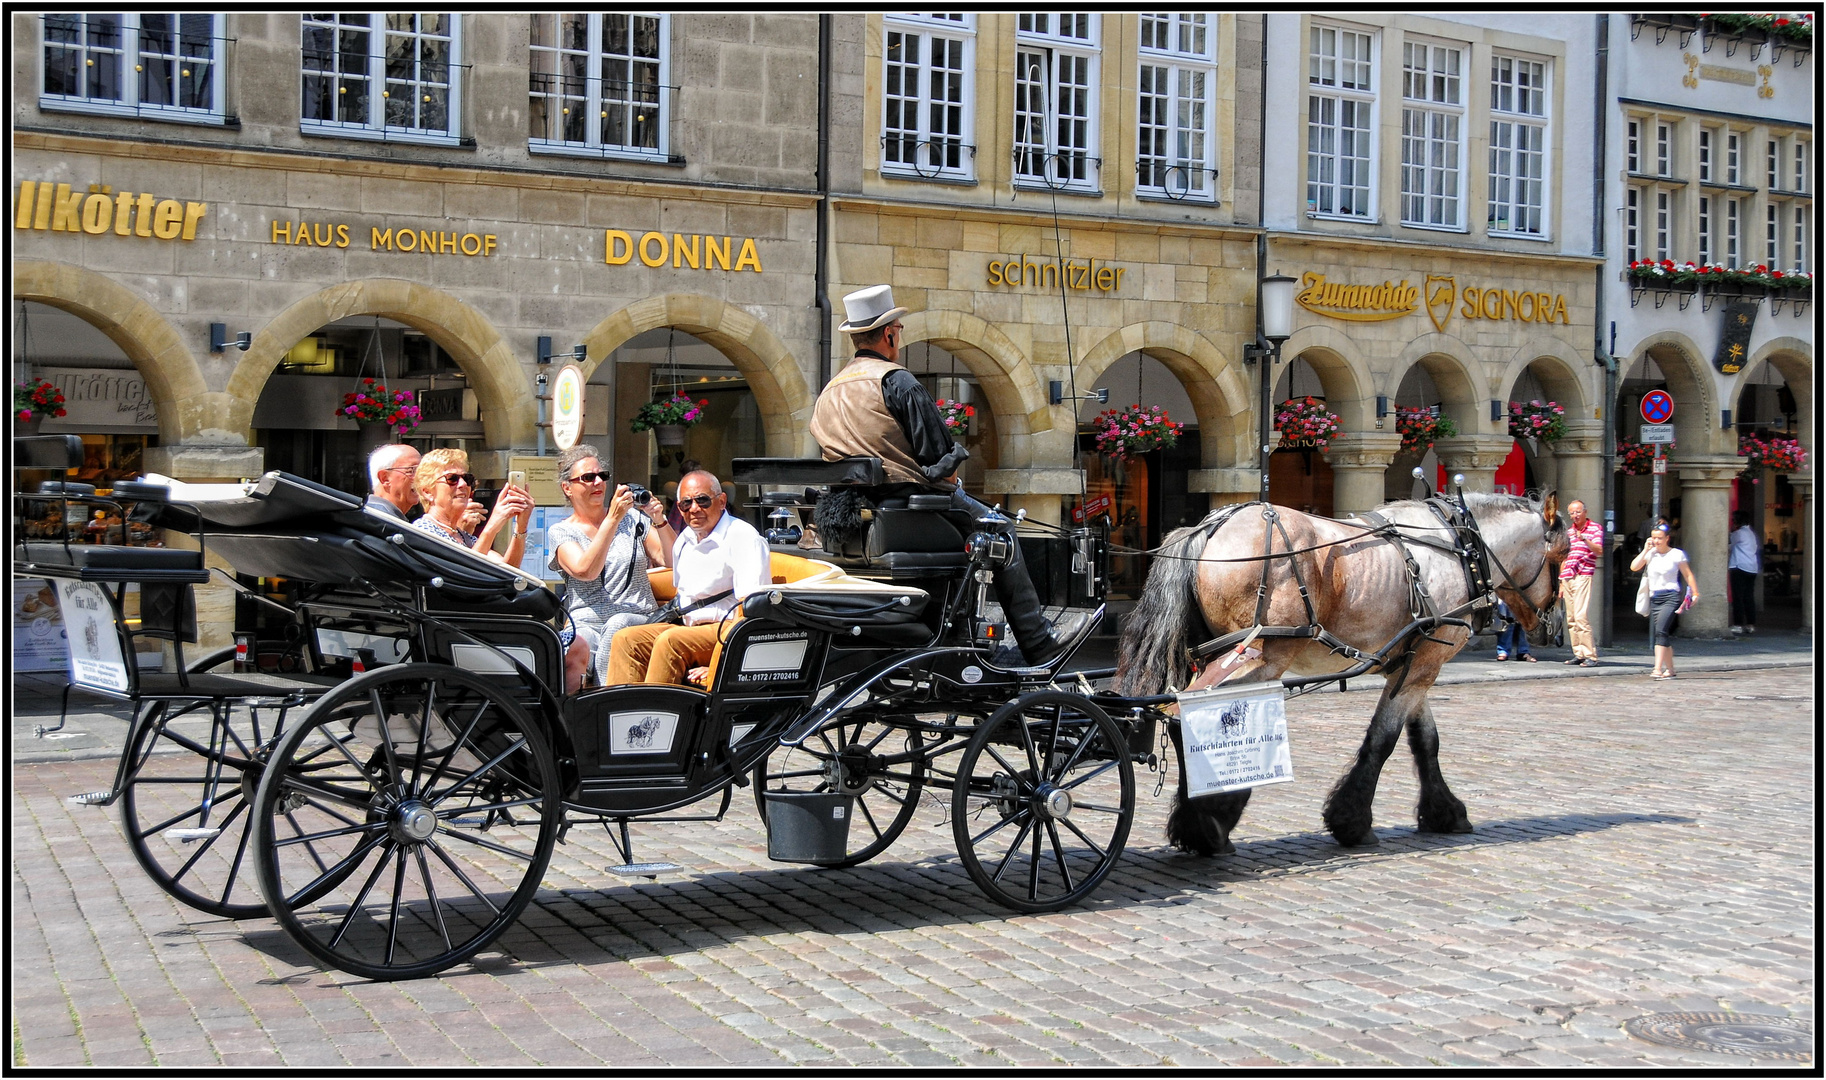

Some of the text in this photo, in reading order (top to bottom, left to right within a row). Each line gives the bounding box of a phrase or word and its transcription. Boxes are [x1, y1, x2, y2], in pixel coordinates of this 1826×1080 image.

[16, 181, 206, 240] llkötter
[272, 220, 497, 256] HAUS MONHOF
[605, 229, 763, 272] DONNA
[987, 253, 1126, 291] schnitzler
[1300, 271, 1420, 311] Zumnorde
[1461, 286, 1570, 325] SIGNORA
[86, 597, 98, 611] Alle
[748, 631, 808, 641] muenster-kutsche.de
[752, 673, 768, 681] 0172
[773, 672, 799, 680] 2702416
[1190, 741, 1243, 753] Kutschfahrten
[1245, 736, 1256, 746] für
[1258, 734, 1273, 743] Alle
[1207, 772, 1274, 788] muenster-kutsche.de
